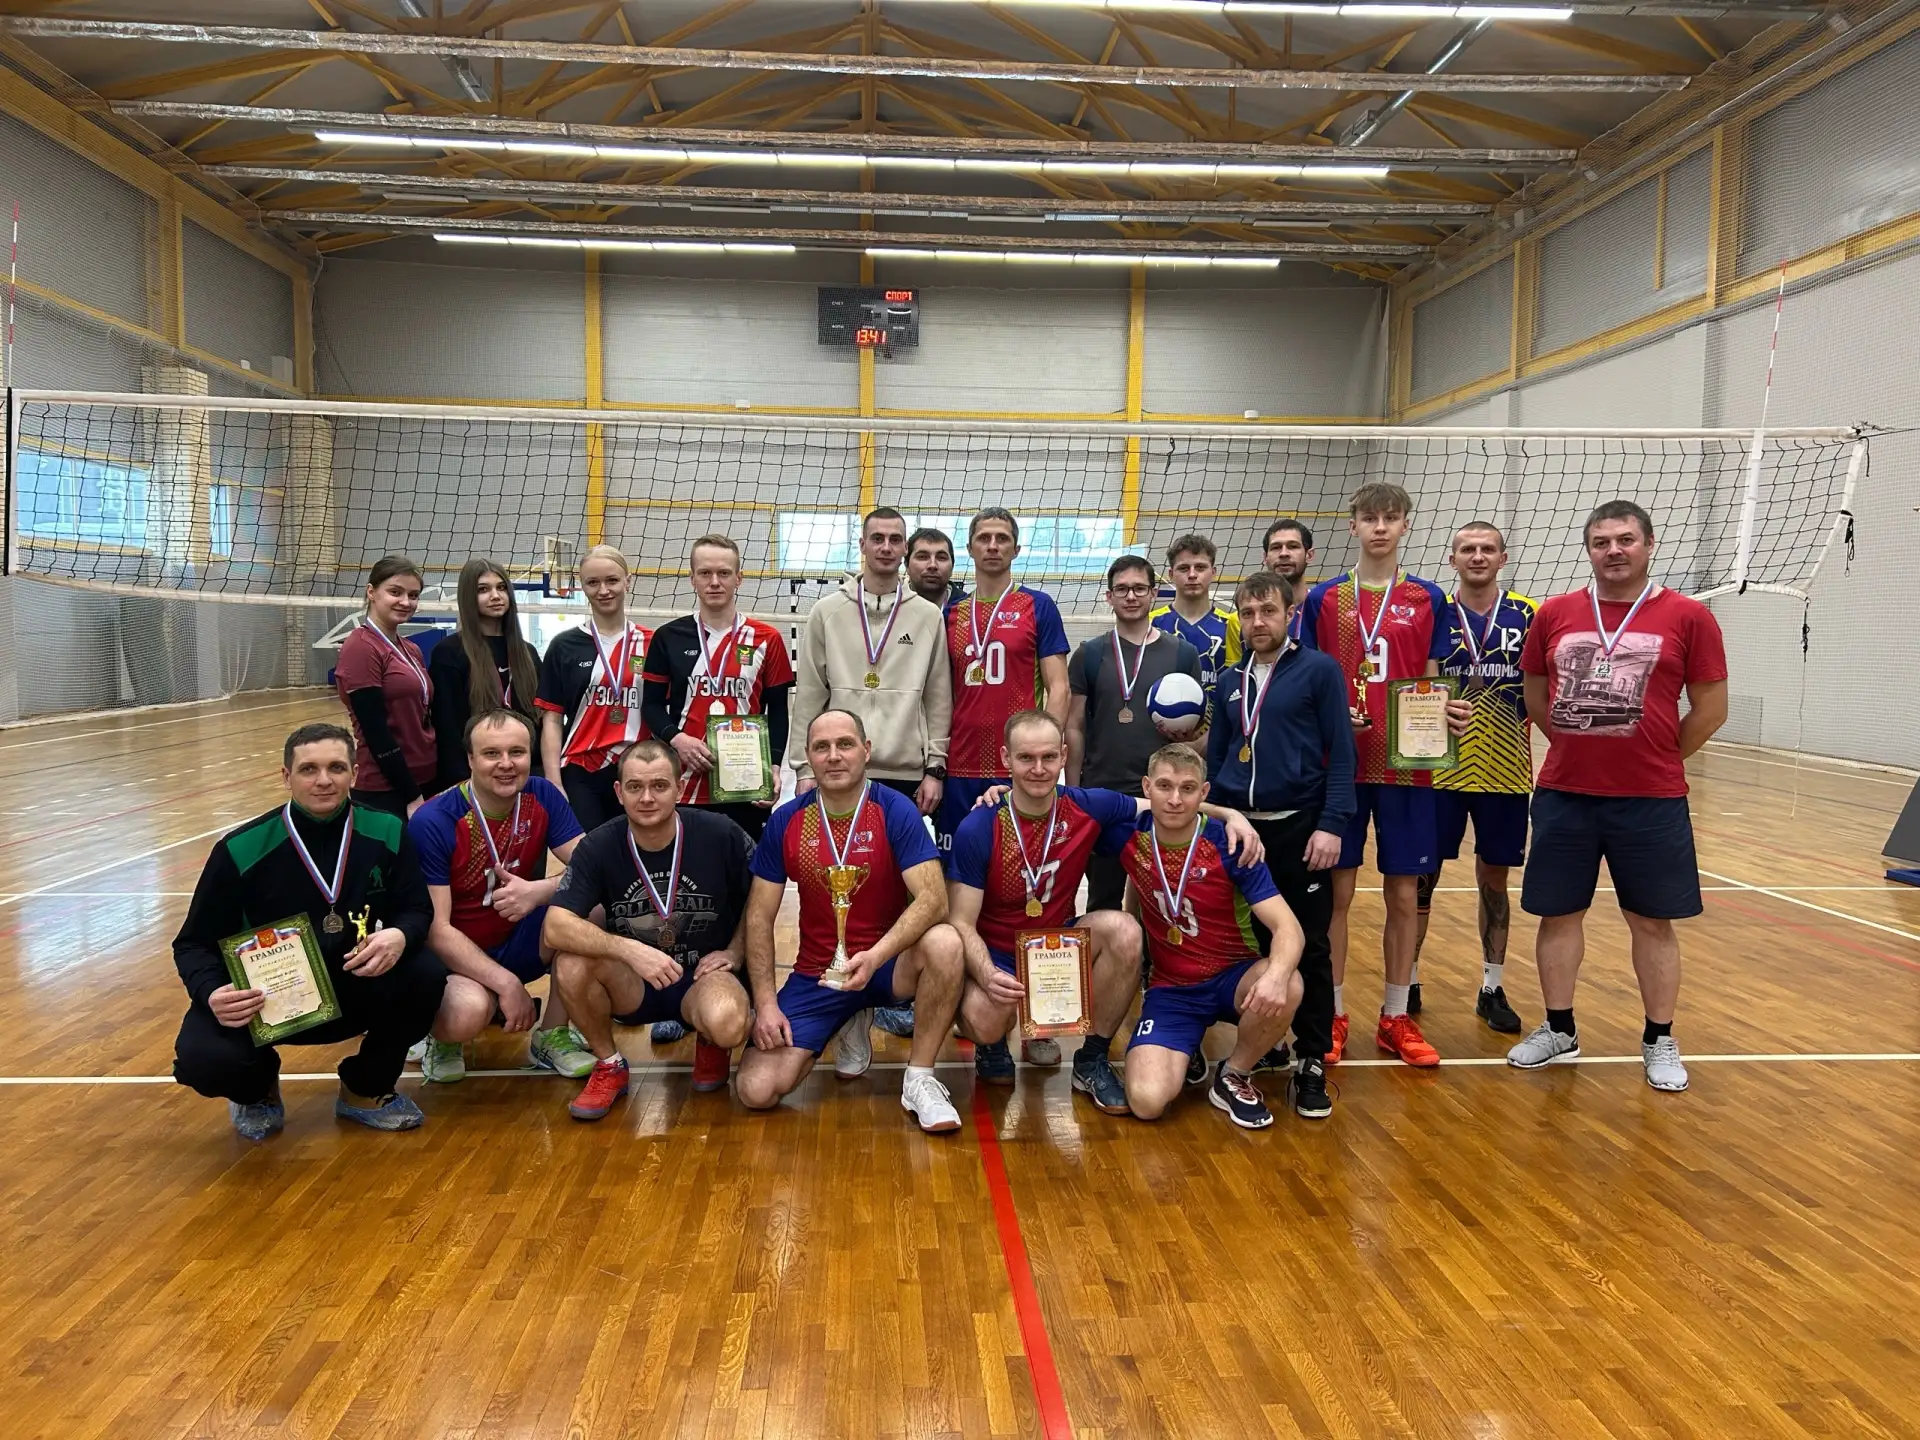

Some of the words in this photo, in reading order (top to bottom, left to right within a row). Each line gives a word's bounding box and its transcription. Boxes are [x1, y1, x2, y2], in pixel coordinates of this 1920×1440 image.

[886, 291, 912, 300] СПОРТ
[1210, 636, 1223, 657] 7
[1501, 628, 1521, 652] 12
[965, 641, 1006, 687] 20
[1365, 636, 1388, 682] 9
[937, 832, 953, 851] 20
[681, 874, 698, 891] WITH
[1020, 860, 1060, 904] 17
[1153, 889, 1199, 937] 13
[250, 943, 295, 962] ГРАМОТА
[1033, 951, 1073, 960] ГРАМОТА
[1136, 1019, 1155, 1037] 13
